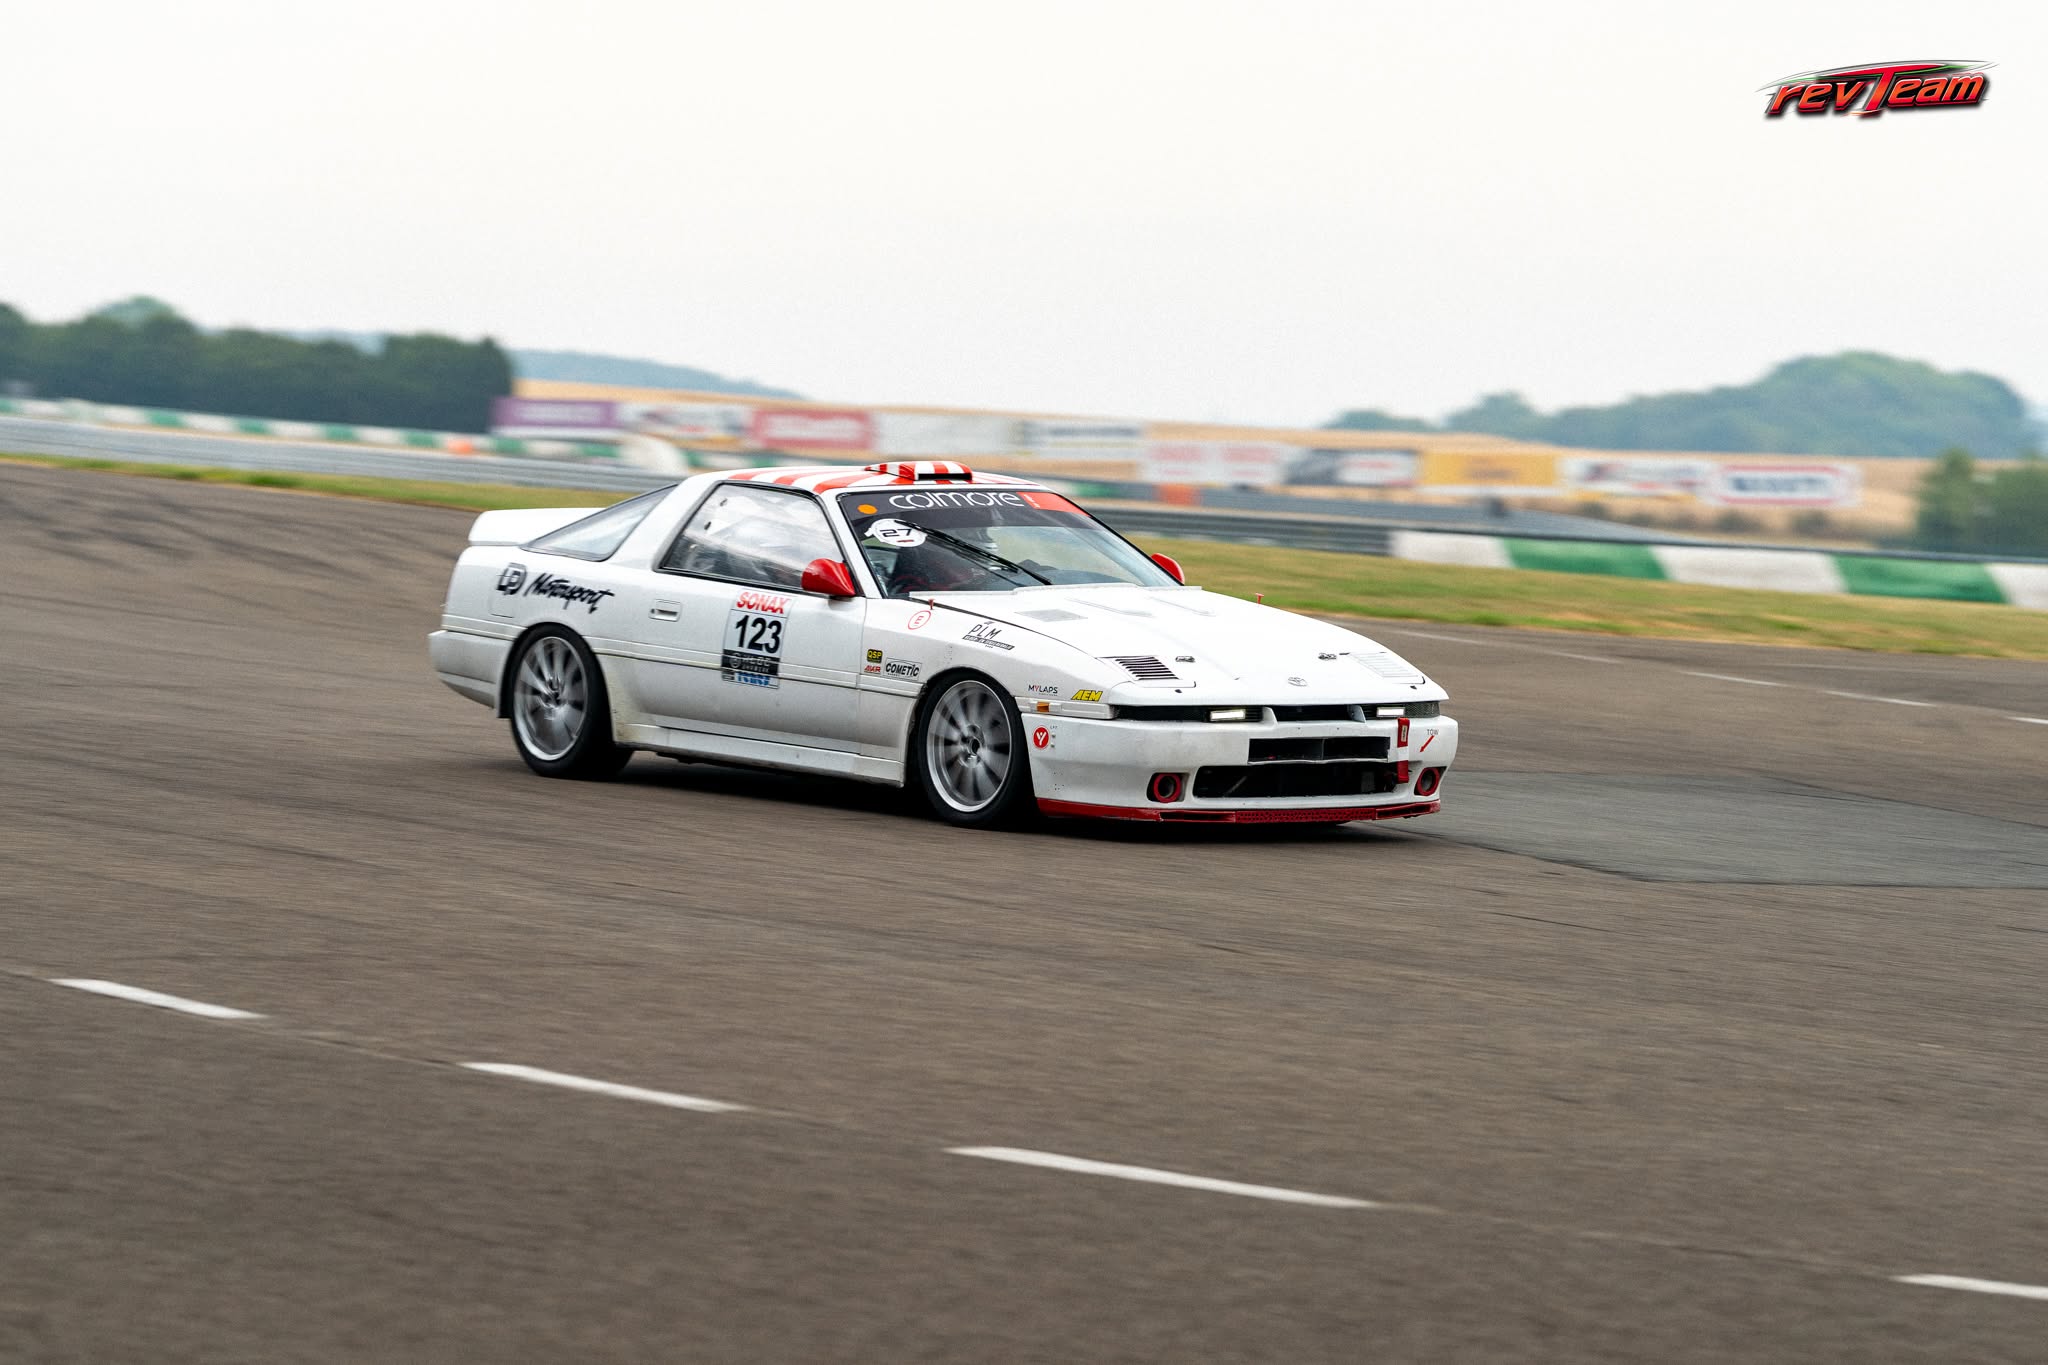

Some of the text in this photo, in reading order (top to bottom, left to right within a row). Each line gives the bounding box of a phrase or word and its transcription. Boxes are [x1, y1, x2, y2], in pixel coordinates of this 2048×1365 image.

[889, 491, 1025, 509] colmore
[880, 528, 912, 538] 27
[736, 591, 790, 614] SONAX
[735, 615, 782, 654] 123
[868, 650, 882, 659] QSP
[885, 662, 920, 677] COMETIC
[1028, 684, 1058, 694] MYLAPS
[1071, 689, 1103, 702] AEM
